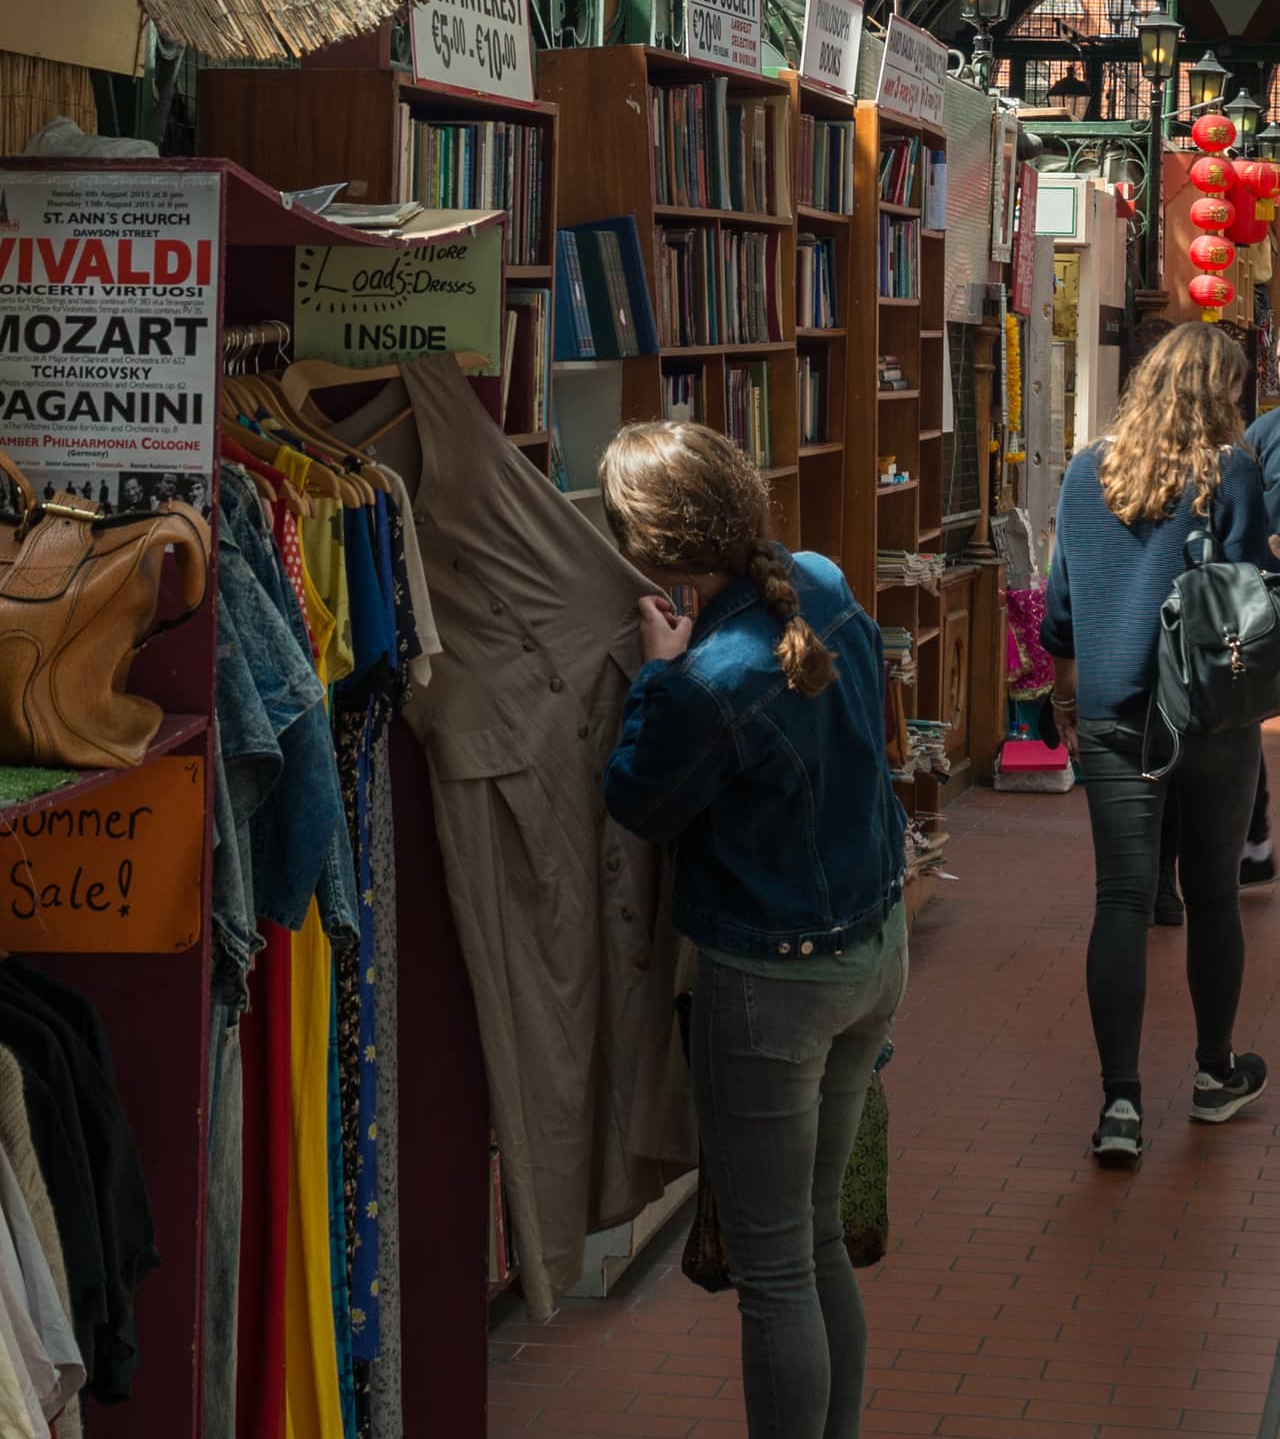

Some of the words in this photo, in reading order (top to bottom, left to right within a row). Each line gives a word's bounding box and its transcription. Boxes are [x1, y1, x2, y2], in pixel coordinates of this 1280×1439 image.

[731, 19, 752, 34] LARGEST
[731, 35, 757, 51] SELECTION
[819, 41, 842, 77] BOOKS
[43, 212, 64, 224] ST.
[122, 213, 191, 225] CHURCH
[73, 228, 119, 238] DAWSON
[122, 229, 160, 238] STREET
[102, 286, 203, 297] VIRTUOSI
[344, 323, 446, 351] INSIDE
[31, 365, 152, 380] TCHAIKOVSKY
[43, 434, 137, 450] PHILHARMONIA
[141, 437, 201, 451] COLOGNE
[67, 449, 109, 459] (Germany)
[10, 859, 133, 920] Sale!
